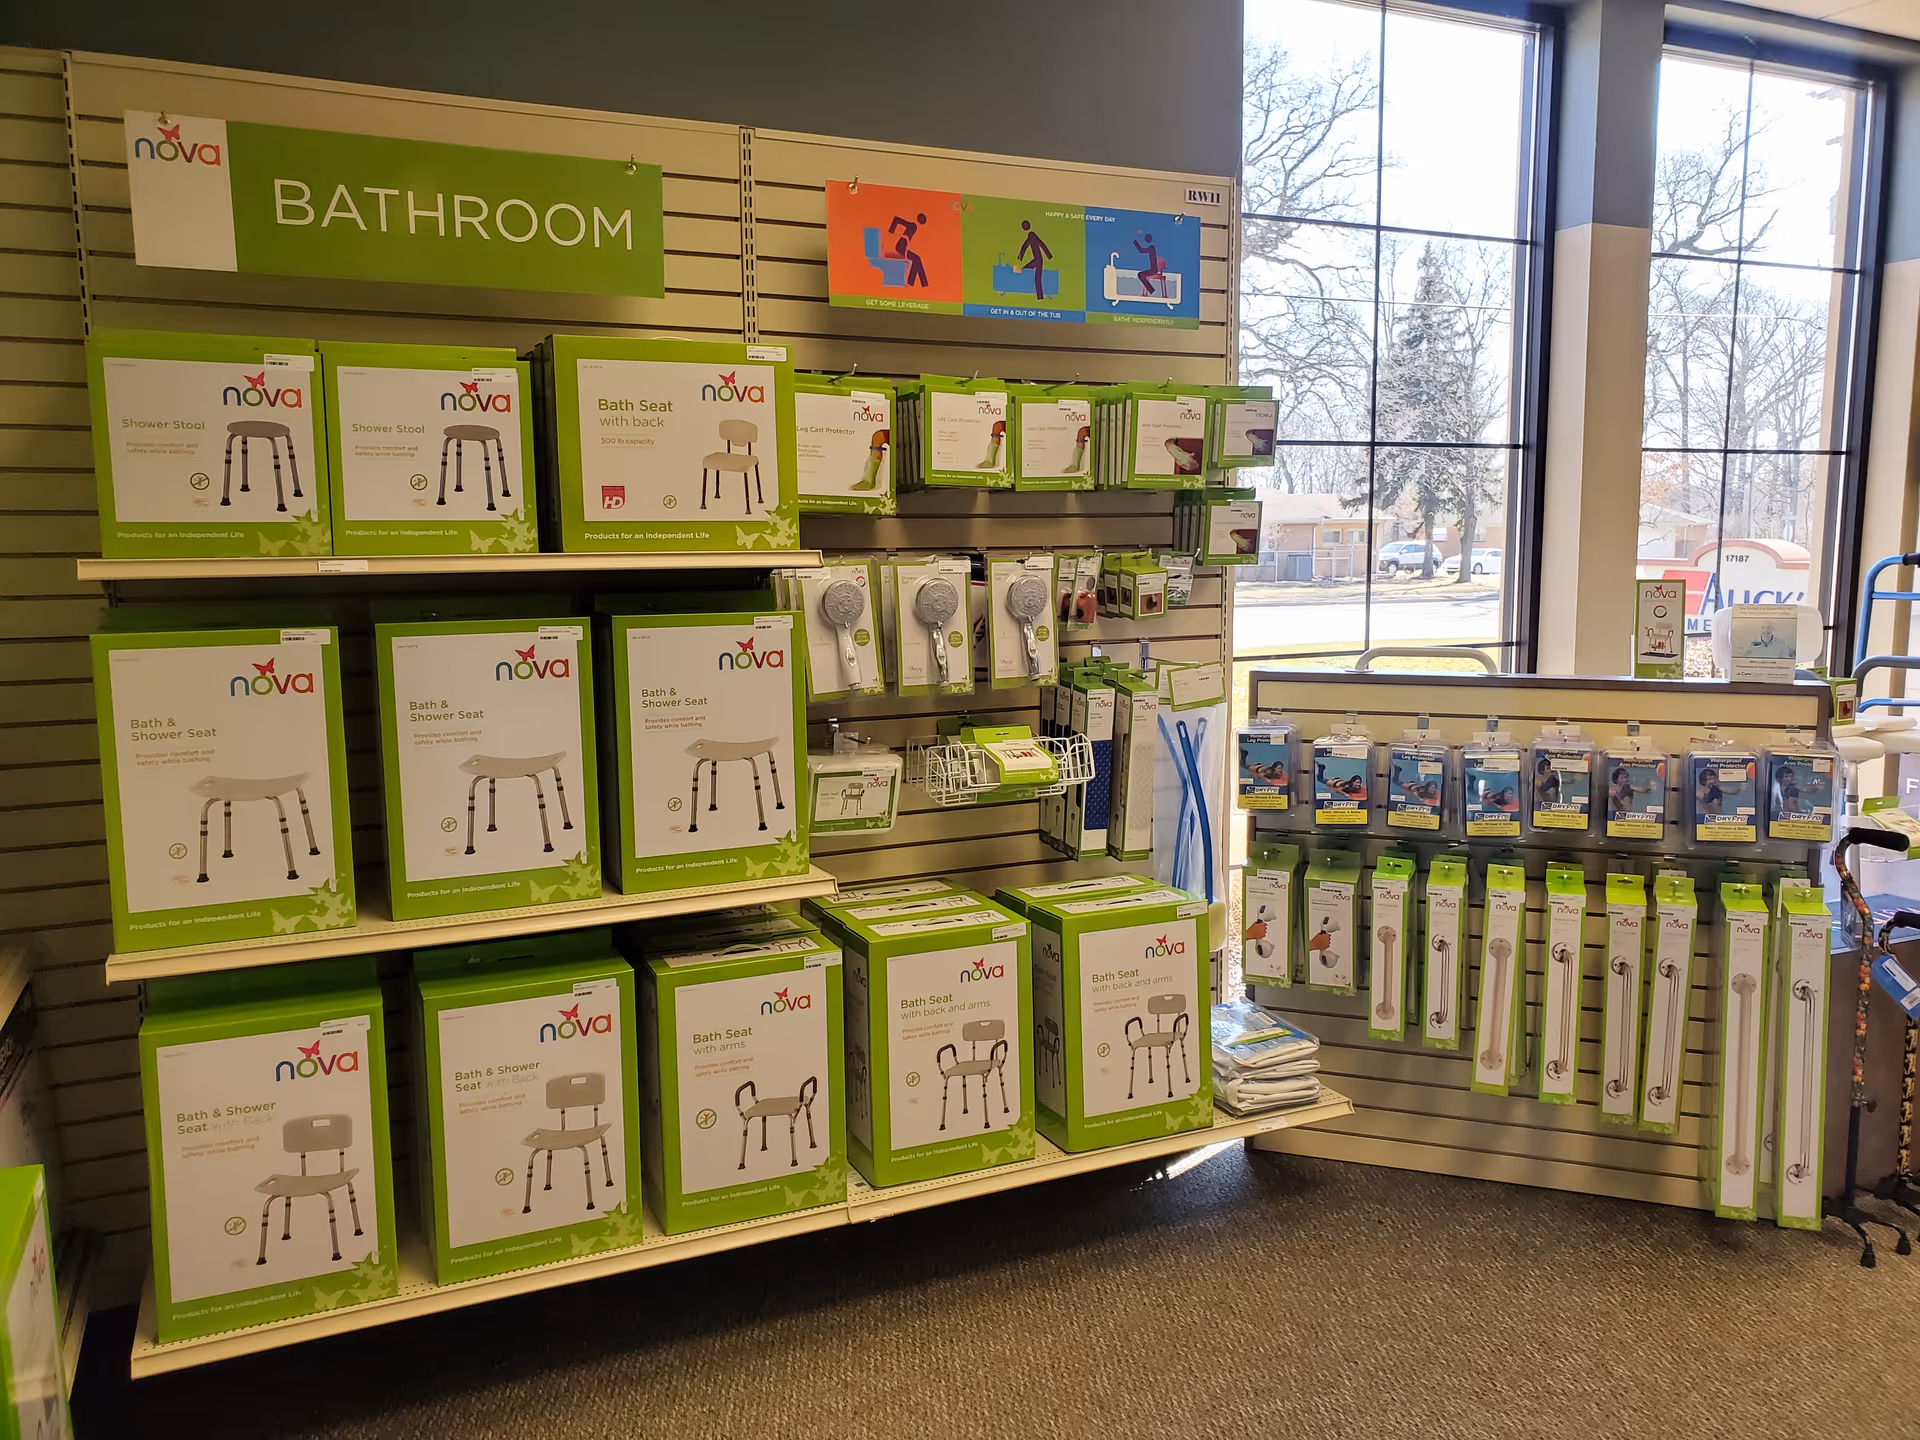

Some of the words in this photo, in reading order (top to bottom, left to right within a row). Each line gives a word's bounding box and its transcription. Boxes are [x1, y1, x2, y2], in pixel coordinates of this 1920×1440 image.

[134, 135, 221, 166] nova
[274, 178, 633, 250] BATHROOM
[898, 301, 929, 310] LEVERAGE
[223, 386, 302, 408] nova
[702, 384, 764, 403] nova
[440, 392, 511, 413] nova
[598, 398, 634, 412] Bath
[639, 399, 673, 412] Seat
[978, 406, 1001, 415] nova
[122, 418, 169, 429] Shower
[172, 420, 205, 430] Stool
[600, 415, 630, 427] with
[632, 416, 665, 428] back
[854, 411, 883, 422] nova
[1065, 414, 1086, 422] nova
[1180, 412, 1201, 420] nova
[352, 423, 393, 433] Shower
[396, 424, 425, 434] Stool
[809, 426, 824, 434] Cast
[825, 426, 856, 435] Protector
[625, 438, 655, 446] capacity
[603, 496, 623, 509] HD
[584, 532, 620, 540] Products
[646, 530, 694, 540] Independent
[1645, 589, 1676, 599] nova
[719, 650, 784, 670] nova
[496, 658, 569, 681] nova
[230, 672, 314, 697] nova
[641, 687, 666, 698] Bath
[669, 687, 677, 697] &
[409, 699, 437, 711] Bath
[440, 698, 449, 709] &
[642, 698, 681, 709] Shower
[684, 696, 708, 706] Seat
[130, 717, 163, 729] Bath
[167, 716, 177, 727] &
[410, 712, 454, 722] Shower
[458, 708, 484, 720] Seat
[131, 730, 183, 741] Shower
[187, 727, 217, 738] Seat
[867, 780, 888, 788] nova
[636, 864, 663, 873] Products
[685, 857, 724, 868] Independent
[407, 888, 438, 898] Products
[462, 881, 506, 892] Independent
[130, 920, 166, 930] Products
[194, 912, 244, 924] Independent
[1666, 921, 1688, 929] nova
[1799, 930, 1823, 939] nova
[1146, 940, 1185, 959] nova
[960, 963, 1004, 984] nova
[1092, 971, 1114, 983] Bath
[1118, 967, 1140, 979] Seat
[1092, 981, 1112, 993] with
[1113, 978, 1133, 990] back
[1135, 975, 1151, 986] and
[1152, 974, 1173, 984] arms
[761, 994, 810, 1016] nova
[900, 996, 926, 1009] Bath
[929, 992, 953, 1005] Seat
[900, 1008, 921, 1020] with
[923, 1004, 946, 1016] back
[948, 1001, 966, 1012] and
[968, 999, 990, 1009] arms
[540, 1013, 611, 1043] nova
[692, 1029, 722, 1044] Bath
[726, 1025, 753, 1040] Seat
[693, 1042, 716, 1056] with
[720, 1040, 746, 1052] arms
[276, 1051, 358, 1082] nova
[454, 1067, 482, 1081] Bath
[485, 1066, 494, 1077] &
[497, 1062, 540, 1075] Shower
[455, 1079, 482, 1092] Seat
[486, 1075, 509, 1088] with
[512, 1071, 539, 1084] Back
[176, 1109, 208, 1123] Bath
[212, 1107, 222, 1118] &
[226, 1102, 276, 1116] Shower
[177, 1121, 208, 1134] Seat
[891, 1153, 914, 1162] Products
[933, 1143, 966, 1155] Independent
